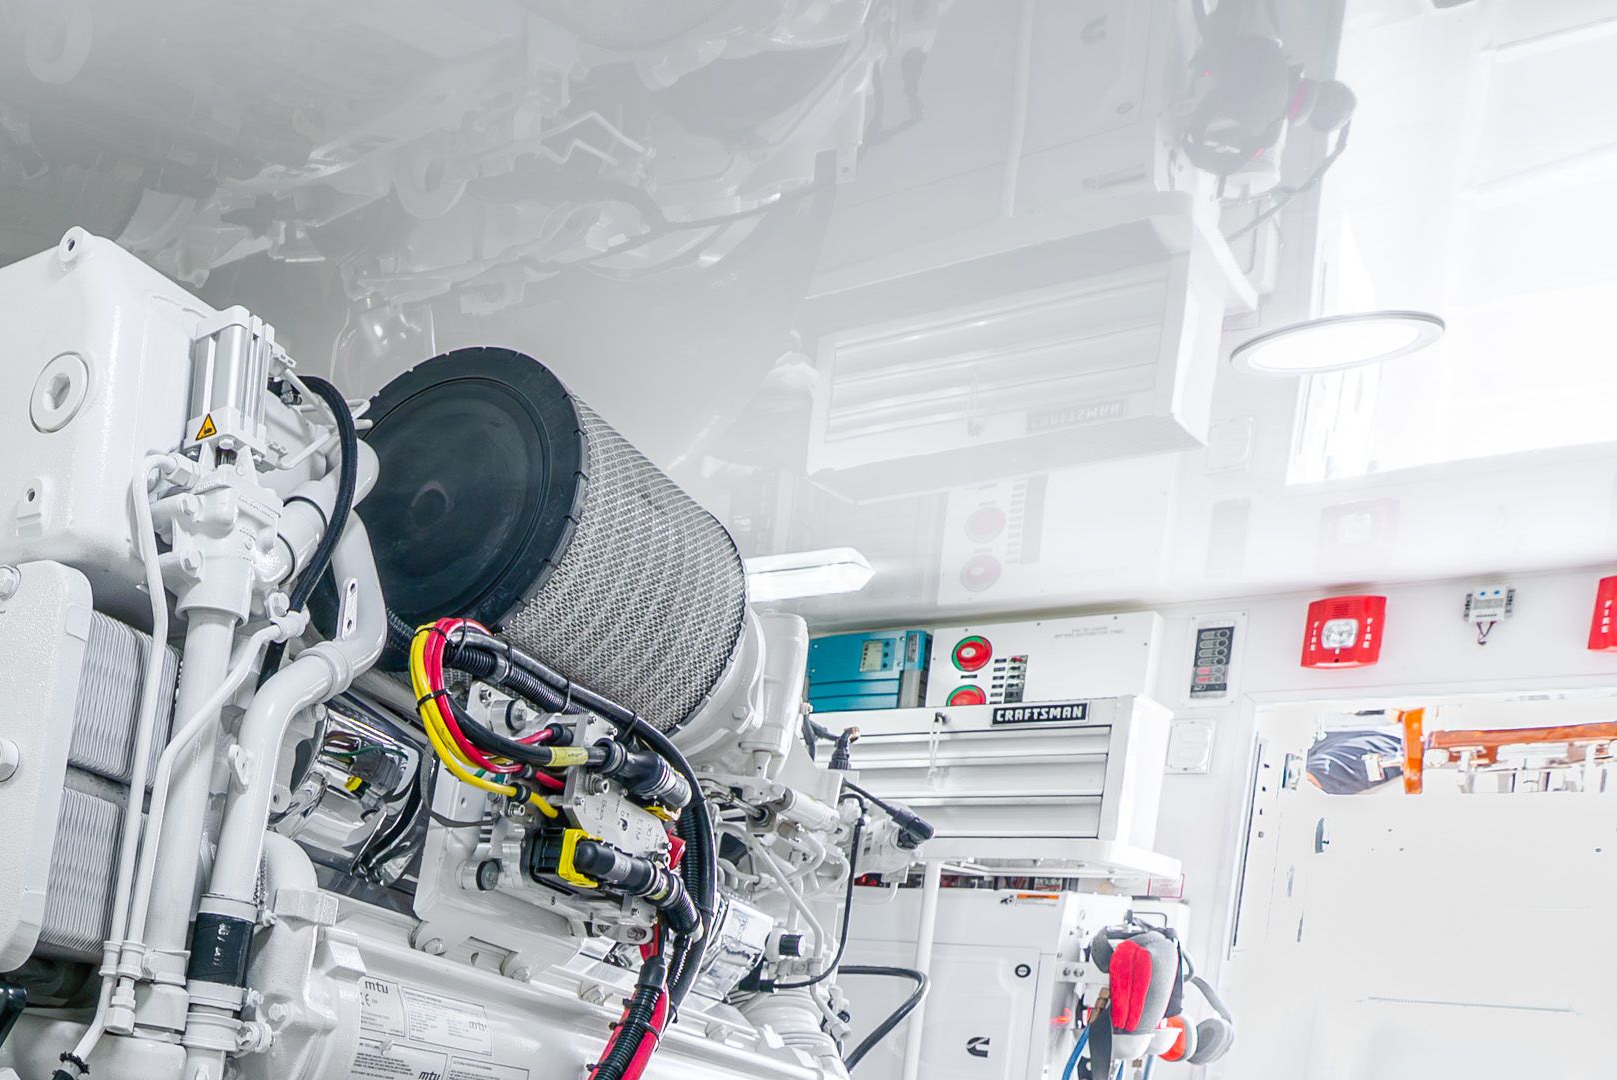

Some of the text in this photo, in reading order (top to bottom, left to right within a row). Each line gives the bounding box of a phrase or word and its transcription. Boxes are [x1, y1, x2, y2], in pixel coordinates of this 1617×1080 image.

[1601, 600, 1613, 634] FIRE
[1310, 621, 1319, 651] FIRE
[1363, 618, 1373, 649] FIRE
[996, 705, 1083, 722] CRAFTSMAN
[365, 980, 389, 994] mtu
